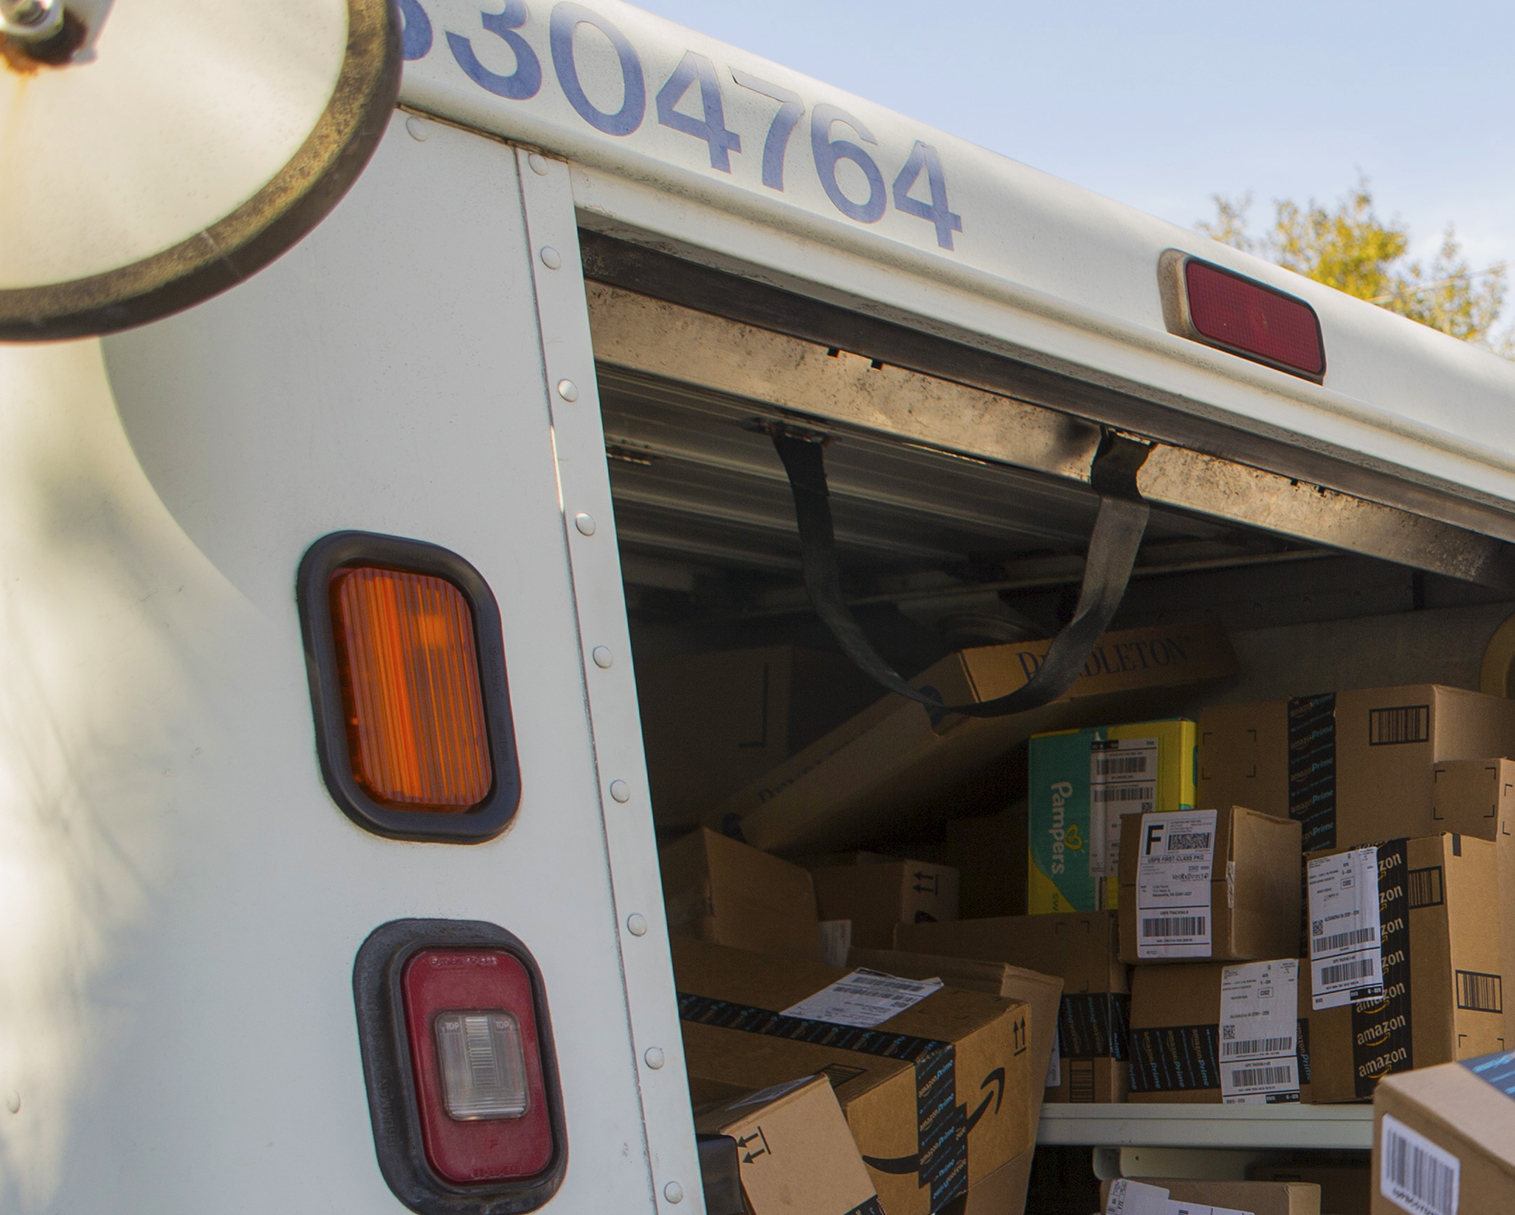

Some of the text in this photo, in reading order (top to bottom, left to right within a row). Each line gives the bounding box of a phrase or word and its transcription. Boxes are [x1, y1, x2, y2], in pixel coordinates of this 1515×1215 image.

[1016, 637, 1188, 682] PDLETON
[1048, 781, 1072, 875] Pampers
[1146, 824, 1164, 855] F
[1357, 1015, 1406, 1046] amazon
[1359, 1047, 1407, 1078] amazon
